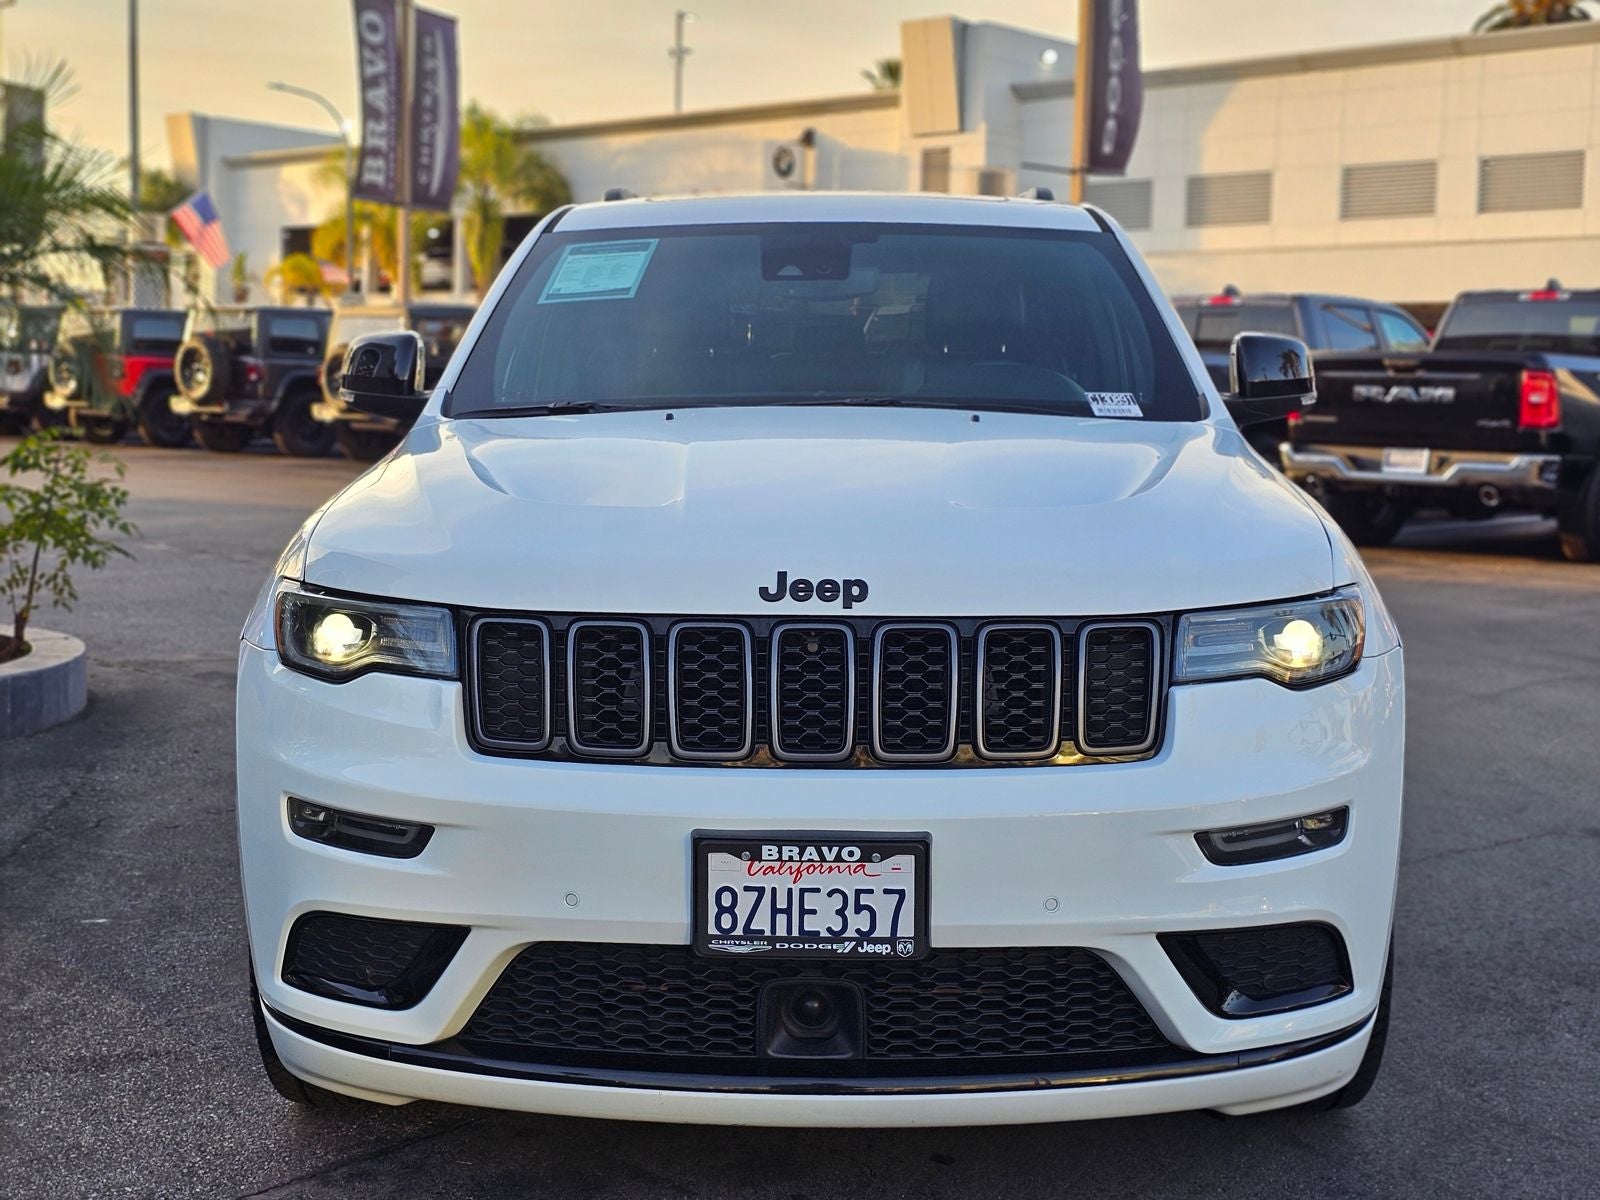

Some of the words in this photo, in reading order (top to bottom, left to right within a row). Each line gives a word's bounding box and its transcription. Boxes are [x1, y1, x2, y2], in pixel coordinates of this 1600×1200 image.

[359, 9, 388, 187] BRAVO
[1352, 384, 1456, 403] RAM
[759, 570, 868, 609] Jeep
[761, 844, 861, 861] BRAVO
[747, 860, 881, 884] California
[714, 885, 906, 938] 8ZHE357
[775, 942, 844, 950] DODGE
